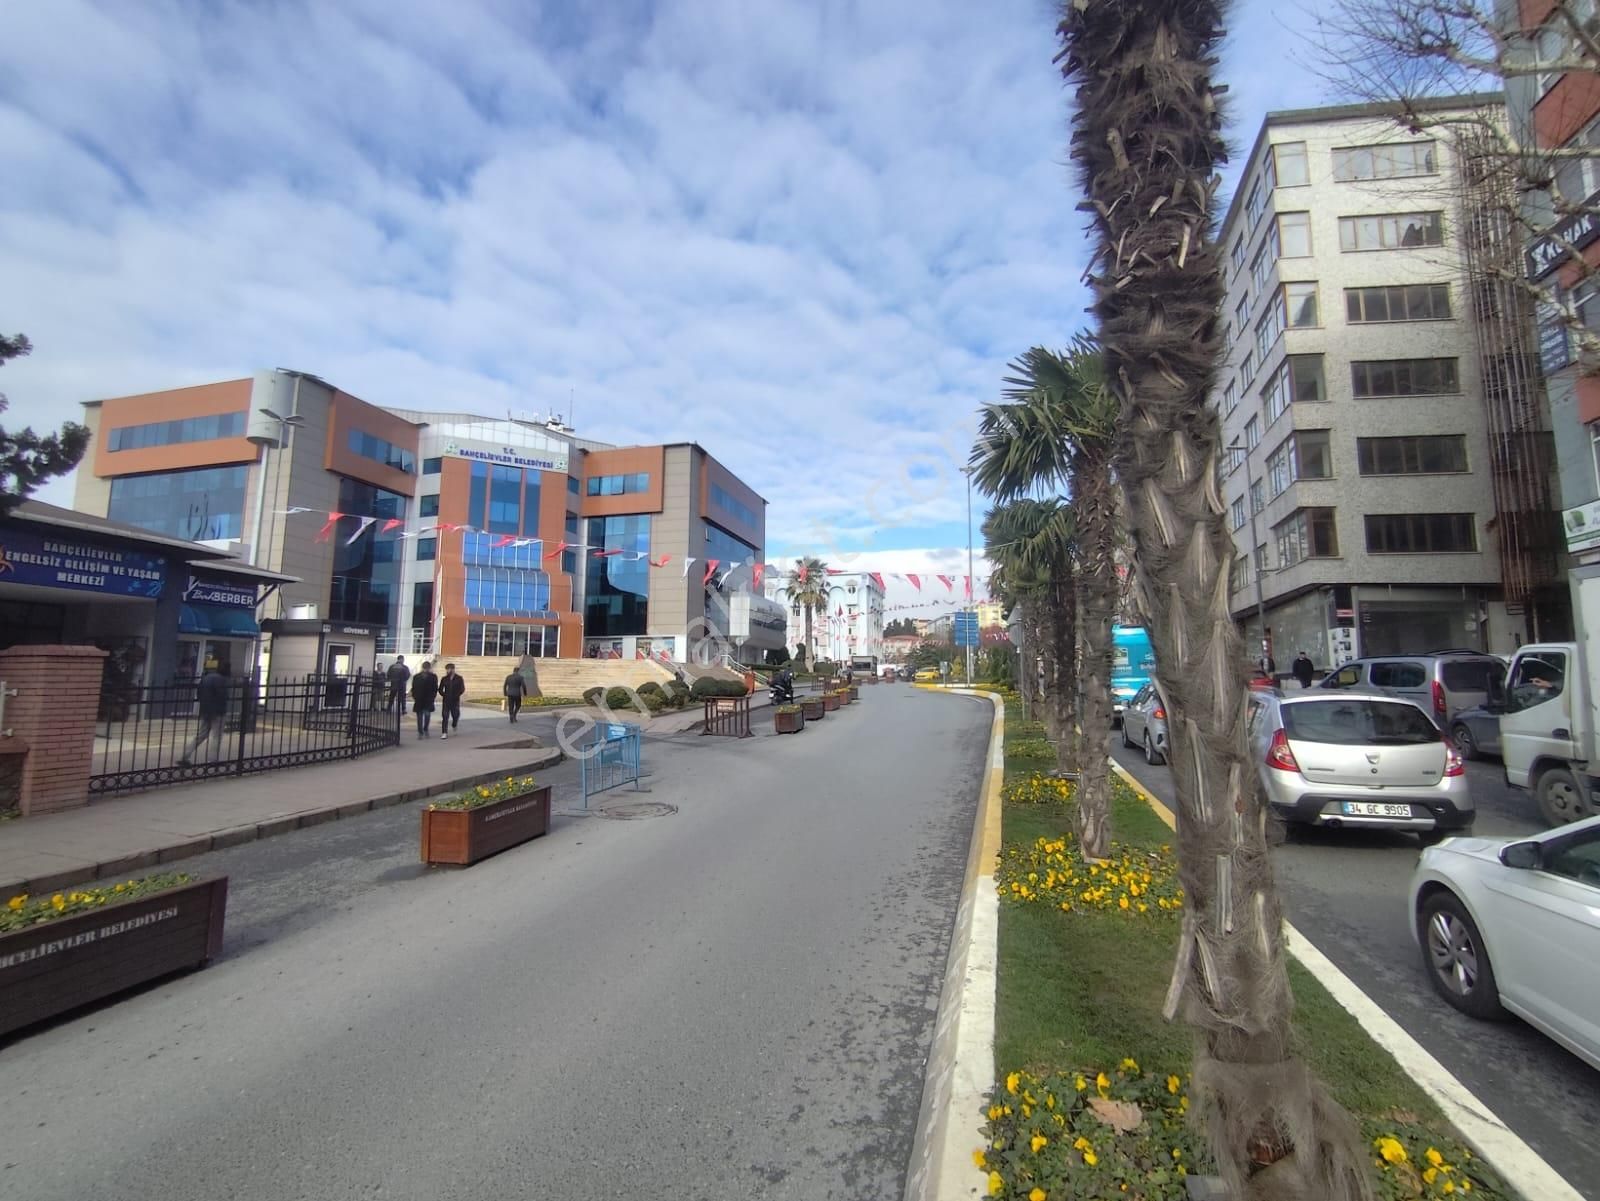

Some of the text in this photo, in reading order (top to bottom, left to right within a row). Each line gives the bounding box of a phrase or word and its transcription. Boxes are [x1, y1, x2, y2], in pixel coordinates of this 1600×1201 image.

[514, 457, 553, 469] BELEDİYESİ
[43, 541, 123, 562] BAHÇELİEVLER
[5, 551, 160, 581] ENGELSİZ GELİŞİM VE YAŞAM
[56, 571, 105, 587] MERKEZİ
[1349, 803, 1362, 814] 34
[1367, 804, 1380, 815] GC
[99, 905, 179, 939] BELEDİYESİ
